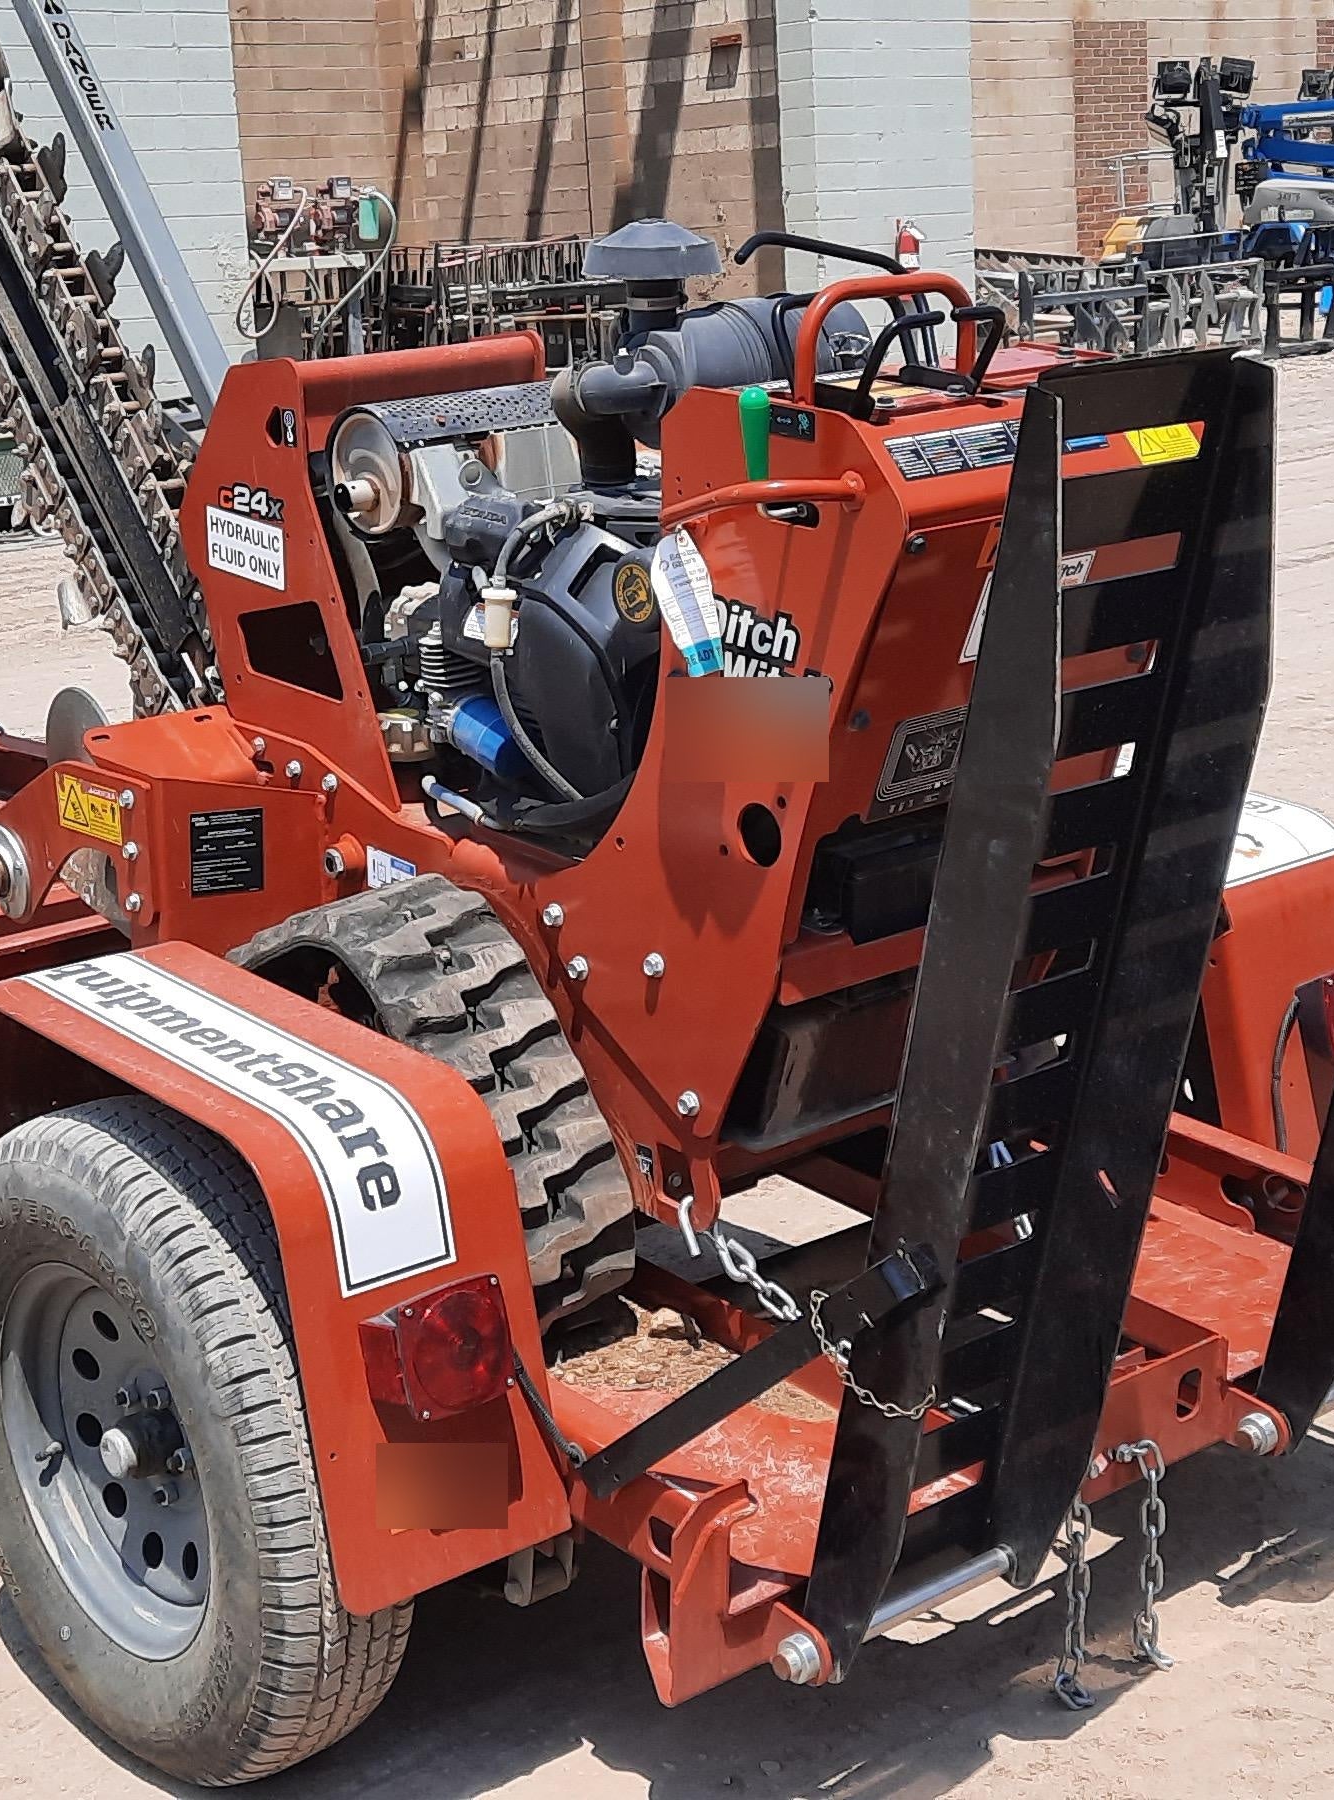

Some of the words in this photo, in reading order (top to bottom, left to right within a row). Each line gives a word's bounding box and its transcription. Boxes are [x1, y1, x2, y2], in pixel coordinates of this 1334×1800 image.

[52, 22, 115, 131] DANGER
[210, 515, 280, 553] HYDRAULIC
[211, 543, 246, 568] FLUID
[249, 555, 280, 580] ONLY
[44, 963, 402, 1213] quipmentShare
